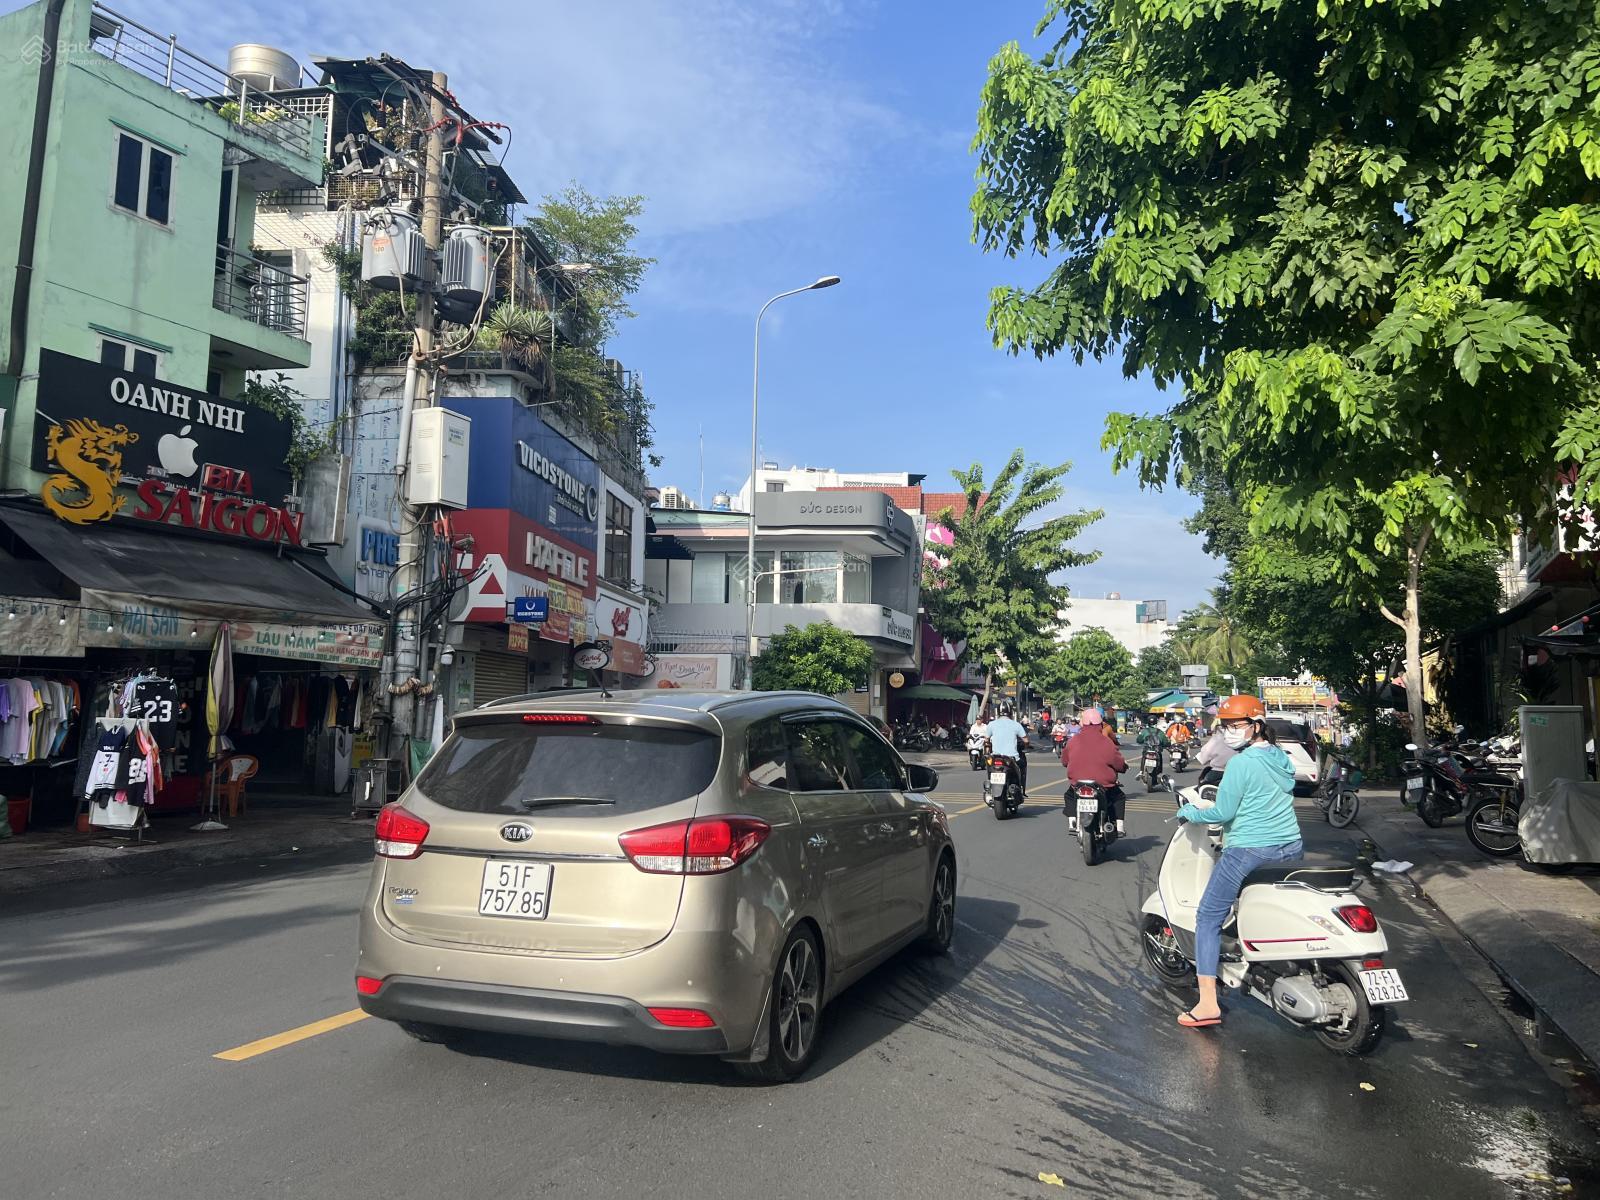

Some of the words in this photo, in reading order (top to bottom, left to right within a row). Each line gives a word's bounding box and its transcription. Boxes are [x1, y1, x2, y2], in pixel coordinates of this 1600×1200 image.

[110, 377, 191, 420] OANH
[199, 400, 245, 434] NHI
[203, 465, 254, 495] BIA
[519, 440, 586, 504] VICOSTONE
[134, 479, 305, 545] SAIGON
[826, 504, 862, 514] DESIGN
[143, 701, 172, 722] 23
[504, 827, 529, 839] KIA
[499, 865, 535, 889] 51F
[482, 888, 545, 915] 757.85
[1369, 985, 1406, 1002] 828.25
